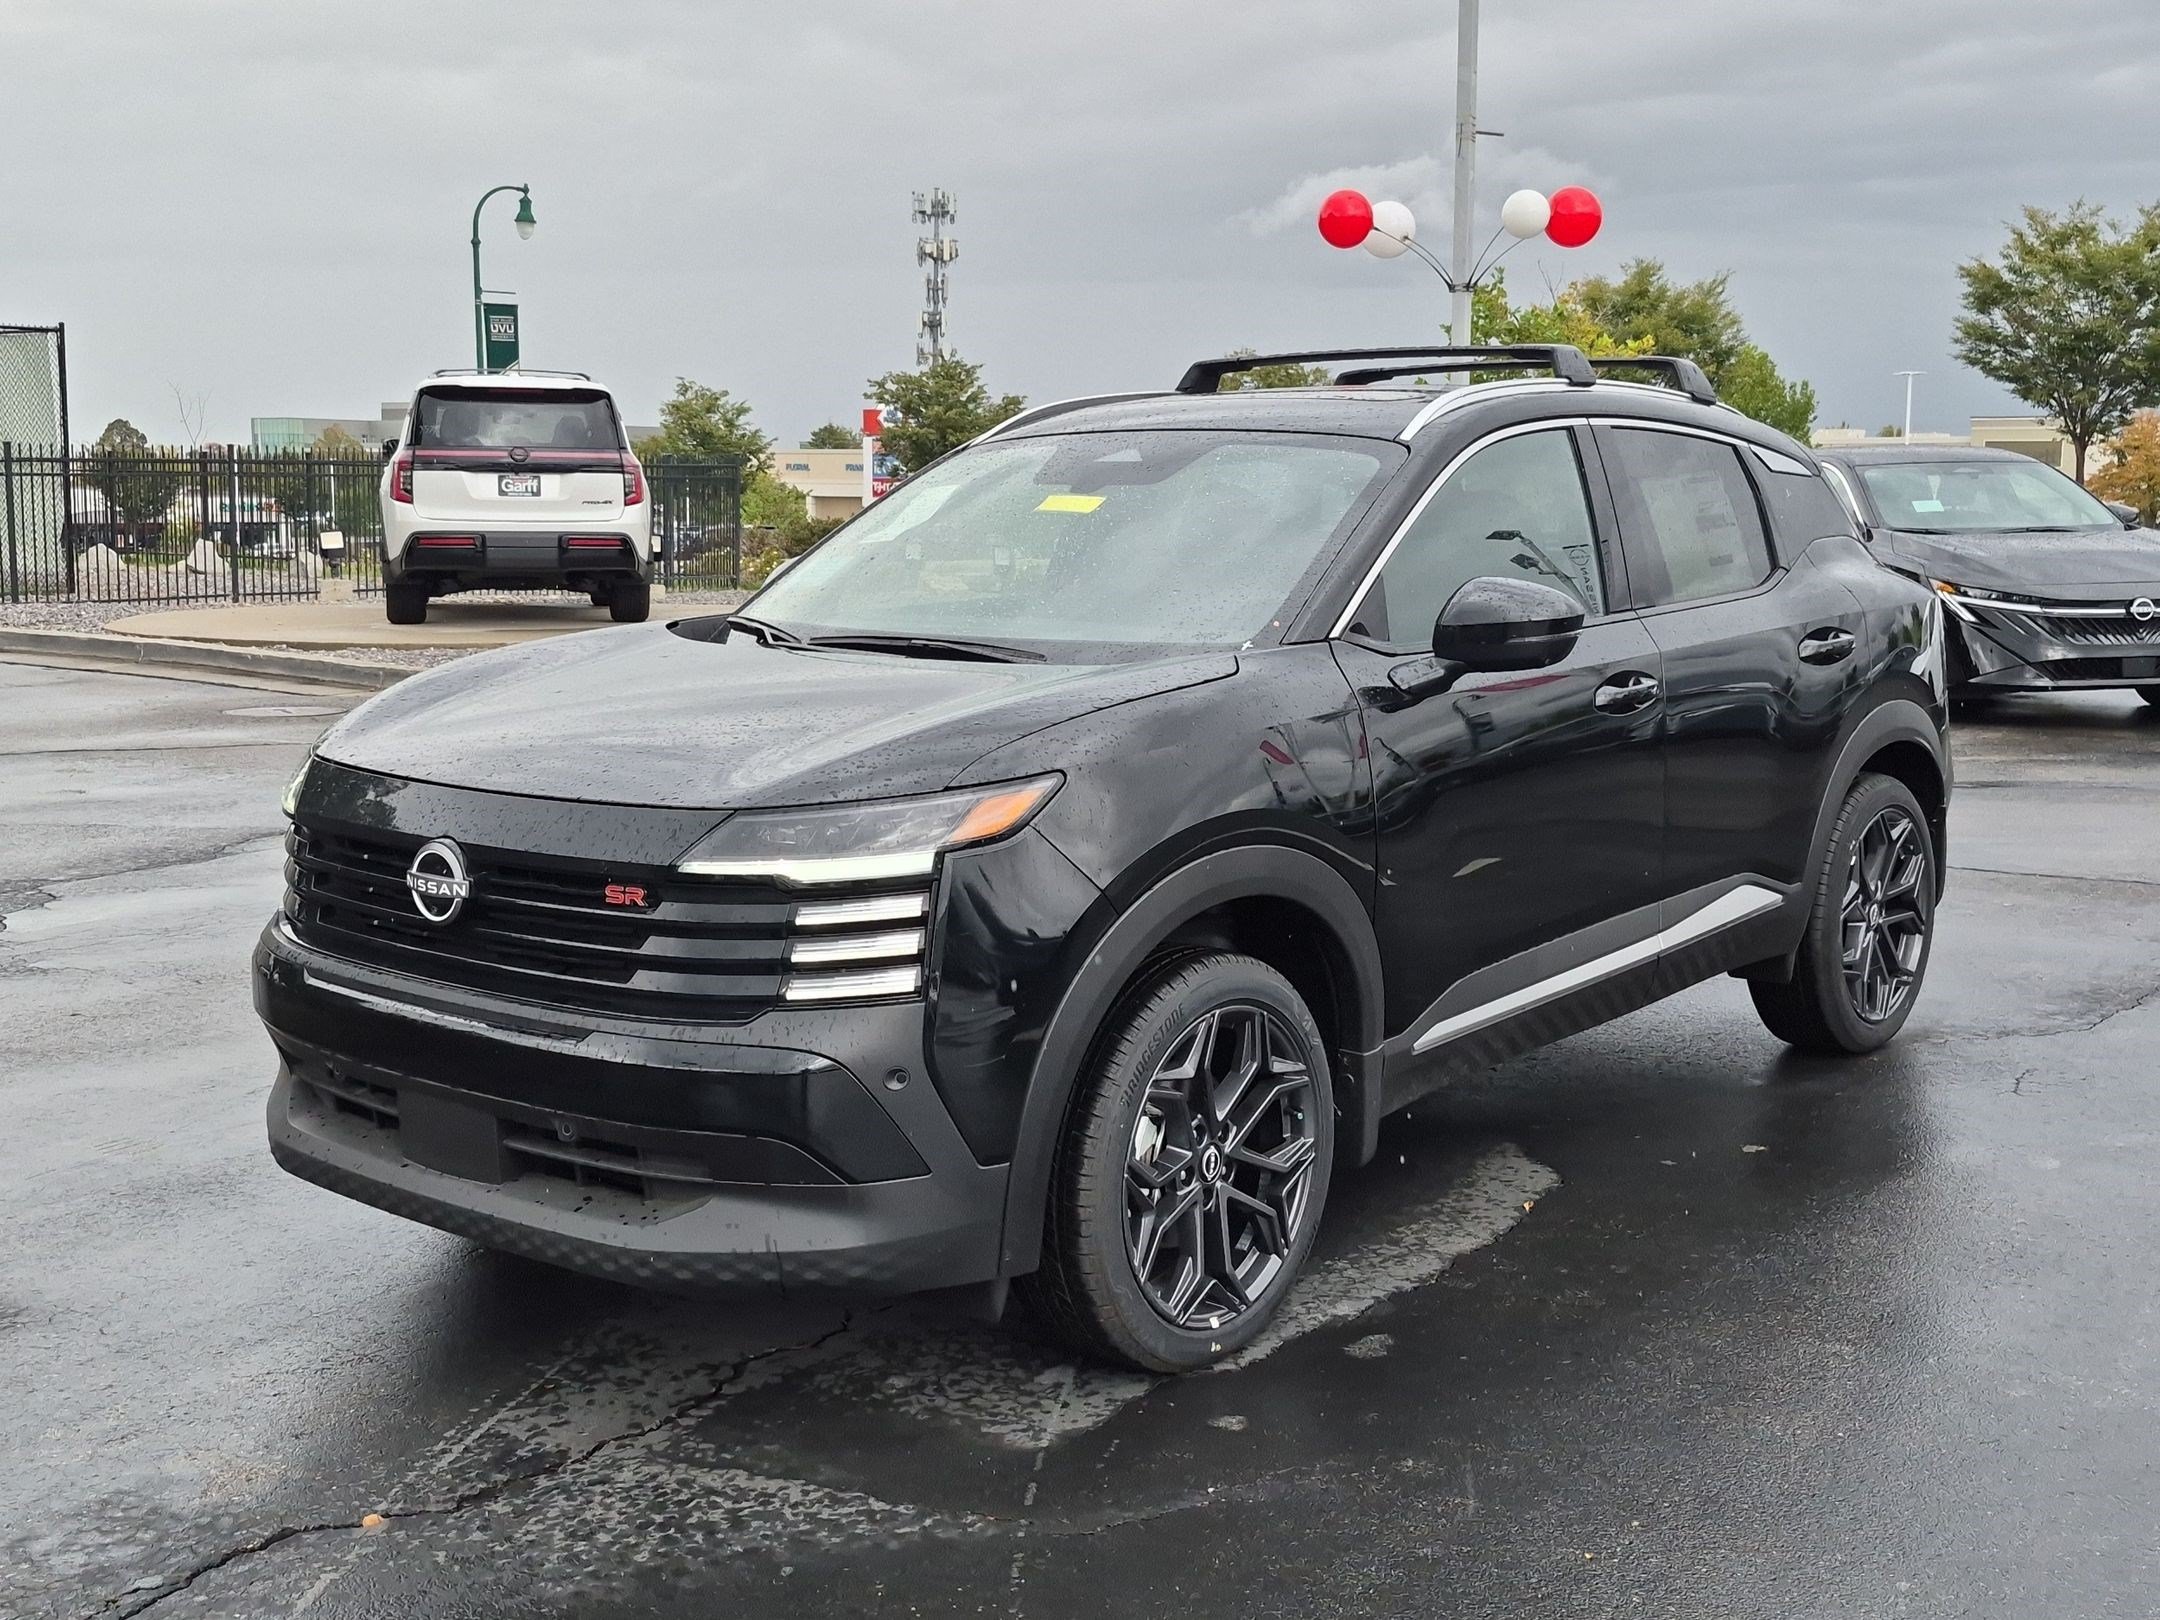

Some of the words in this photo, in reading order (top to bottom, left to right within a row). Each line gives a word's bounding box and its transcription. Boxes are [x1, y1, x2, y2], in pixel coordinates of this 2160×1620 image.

[490, 323, 515, 333] UVU
[501, 478, 538, 493] Garff
[406, 873, 466, 897] NISSAN
[605, 885, 645, 906] SR
